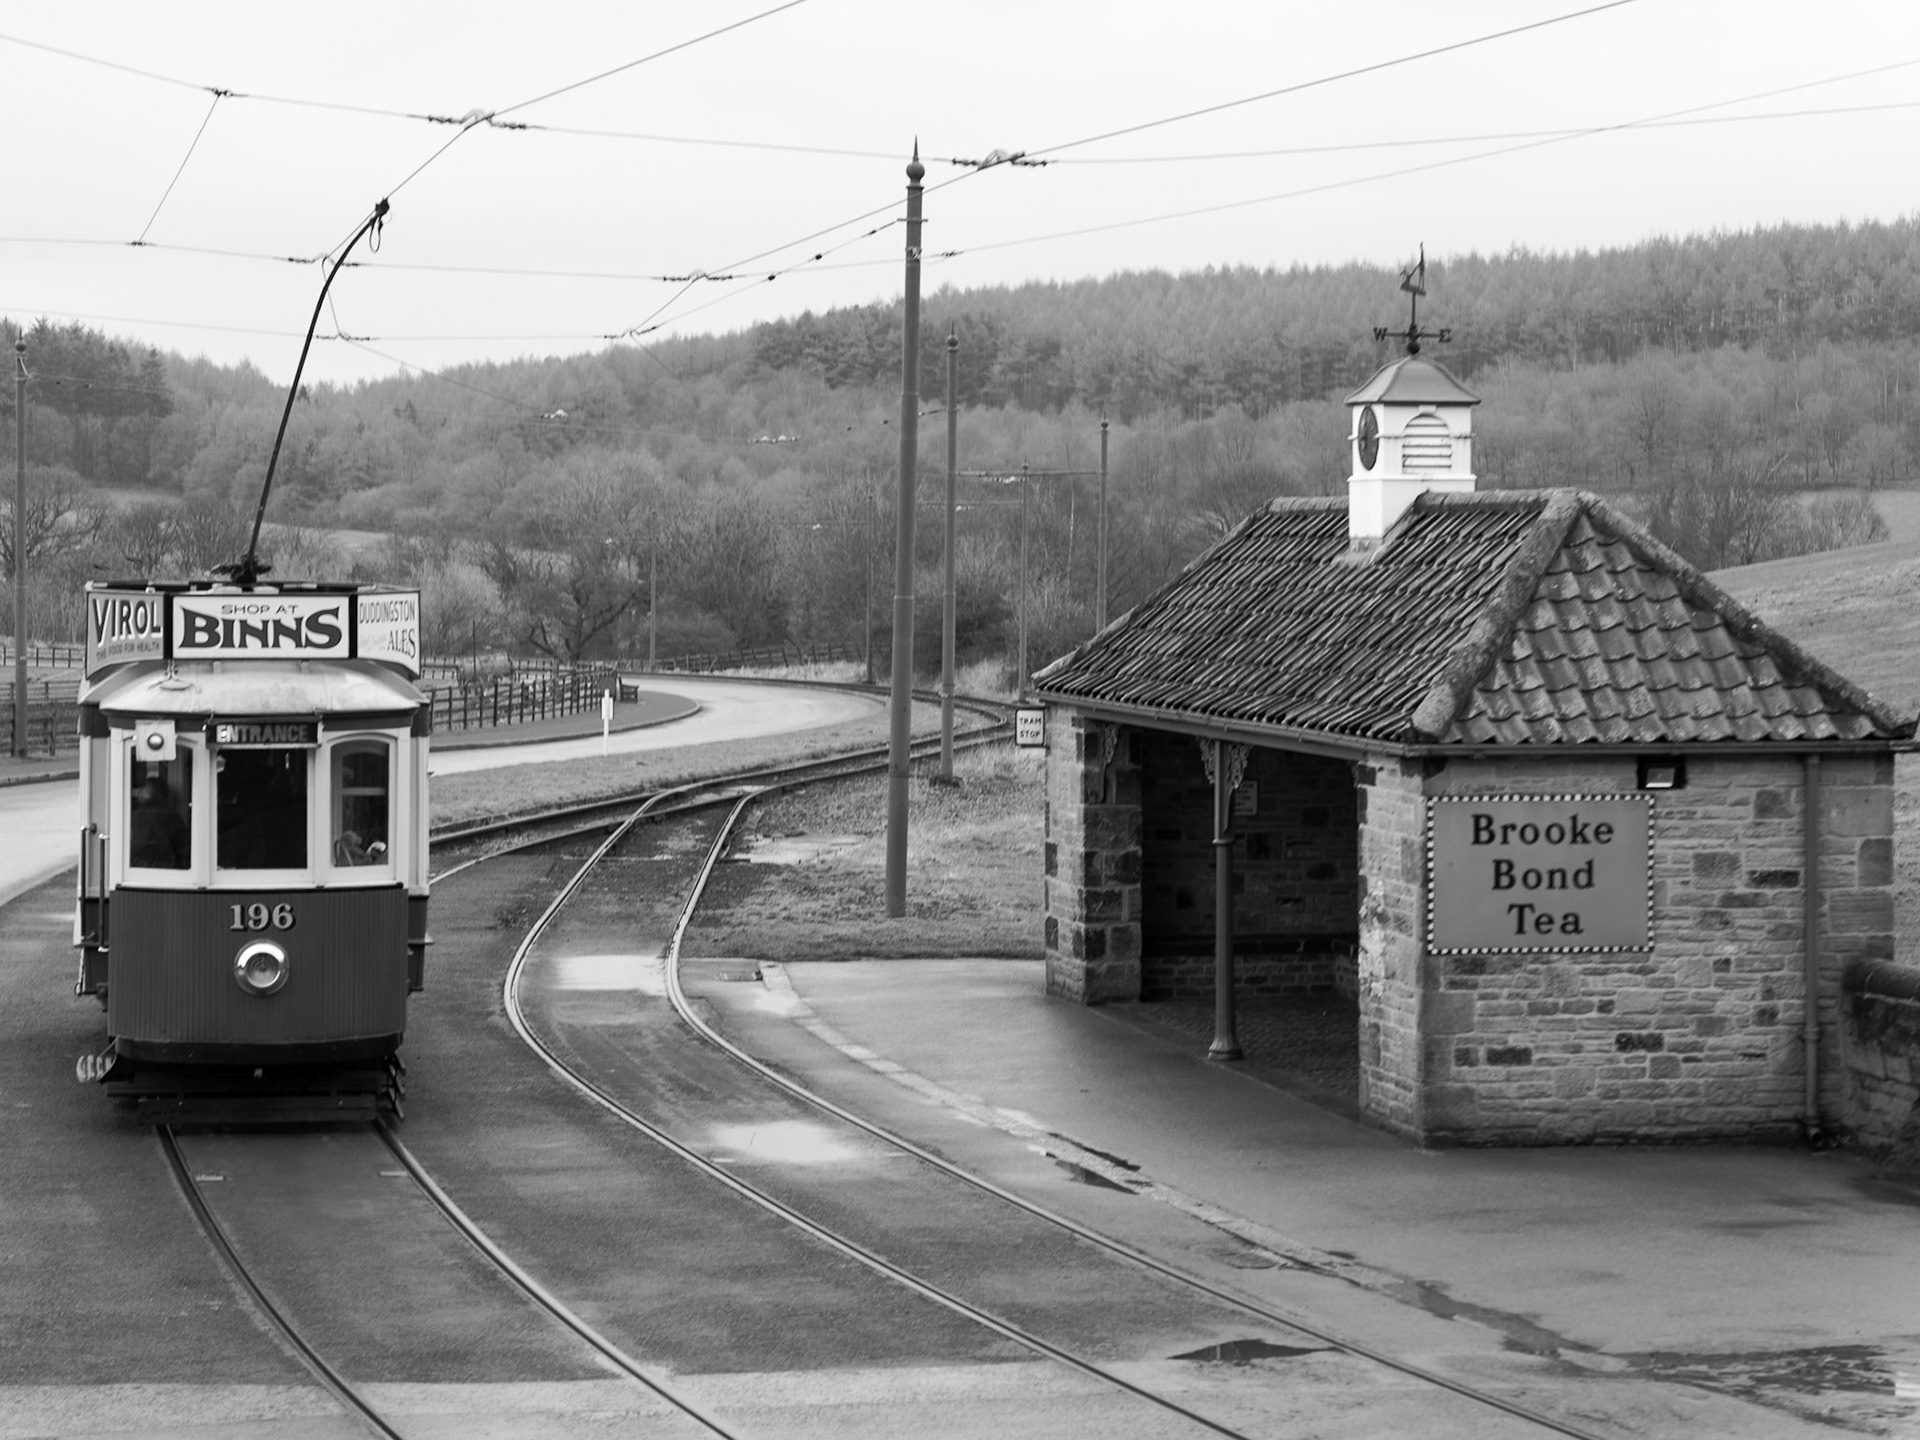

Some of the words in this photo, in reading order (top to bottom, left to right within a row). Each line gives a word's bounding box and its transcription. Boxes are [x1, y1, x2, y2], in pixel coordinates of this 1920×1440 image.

[92, 598, 163, 648] VIROL
[221, 604, 269, 615] SHOP
[275, 604, 299, 615] AT
[359, 600, 416, 624] DUDDINGSTON
[178, 606, 343, 650] BINNS
[387, 628, 416, 659] ALES
[216, 724, 308, 743] ENTRANCE
[1019, 717, 1042, 725] TRAM
[1020, 730, 1041, 738] STOP
[1470, 813, 1615, 846] Brooke
[1491, 858, 1596, 891] Bond
[229, 902, 295, 931] 196
[1507, 903, 1585, 935] Tea
